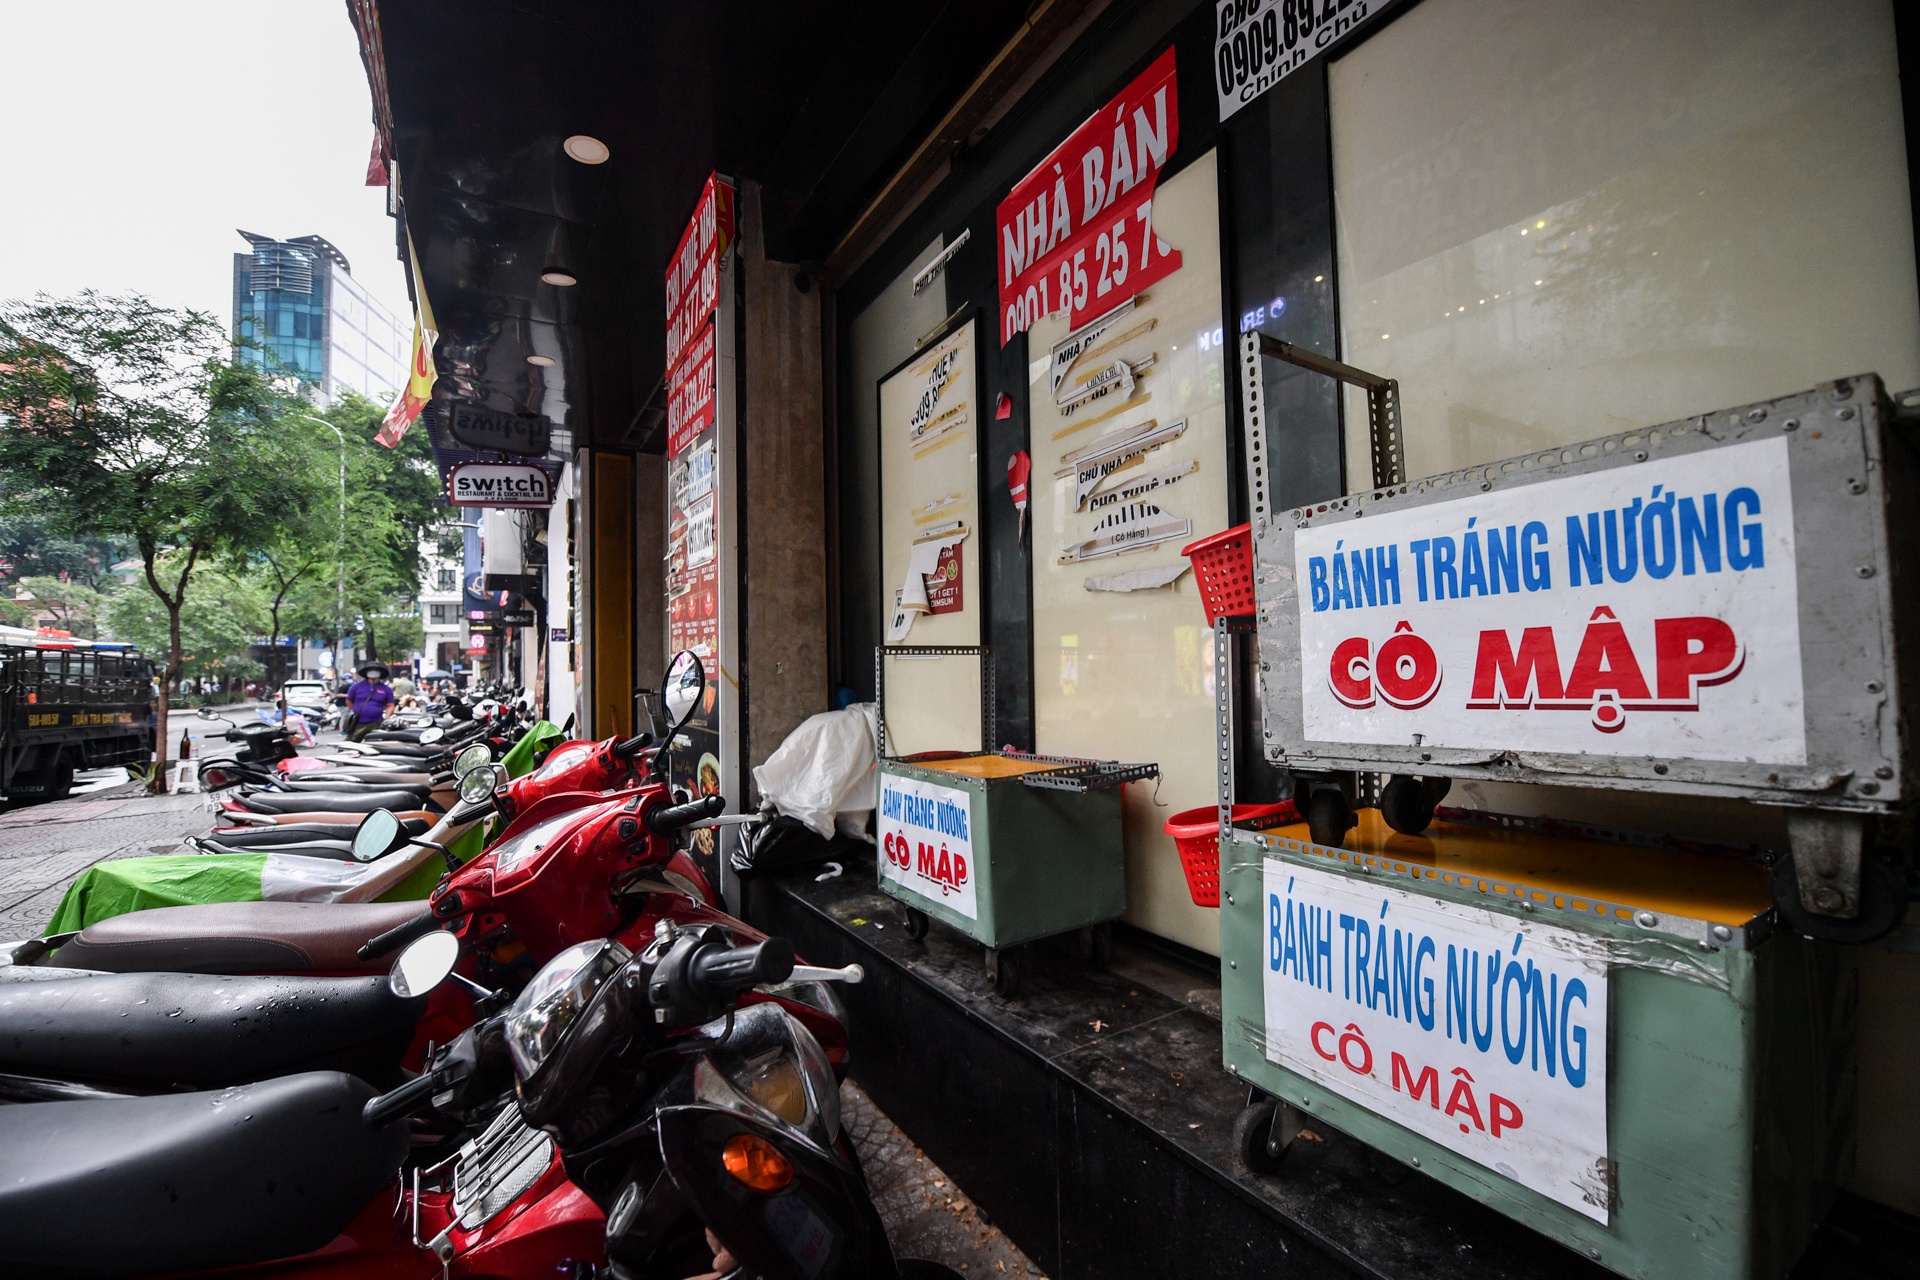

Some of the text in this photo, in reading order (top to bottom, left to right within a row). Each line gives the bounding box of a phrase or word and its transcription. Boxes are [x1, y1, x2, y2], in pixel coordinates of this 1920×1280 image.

[1239, 1, 1368, 103] Chính Chủ
[1002, 84, 1169, 290] NHÀ BÁN
[666, 177, 717, 321] CHO THUÊ NHÀ
[1059, 247, 1089, 319] 85
[1095, 219, 1129, 299] 25
[668, 360, 713, 440] 0931.339.227
[1057, 341, 1080, 365] NHÀ
[1079, 462, 1099, 484] CHỦ
[942, 588, 954, 597] GET
[1308, 484, 1766, 613] BÁNH TRÁNG NƯỚNG
[931, 597, 954, 607] DIMSUM
[1328, 605, 1747, 734] CÔ MẬP
[883, 784, 968, 842] BÁNH TRÁNG NƯỚNG
[884, 829, 968, 896] CÔ MẬP
[1269, 876, 1588, 1089] BÁNH TRÁNG NƯỚNG
[1310, 1021, 1524, 1139] CÔ MẬP
